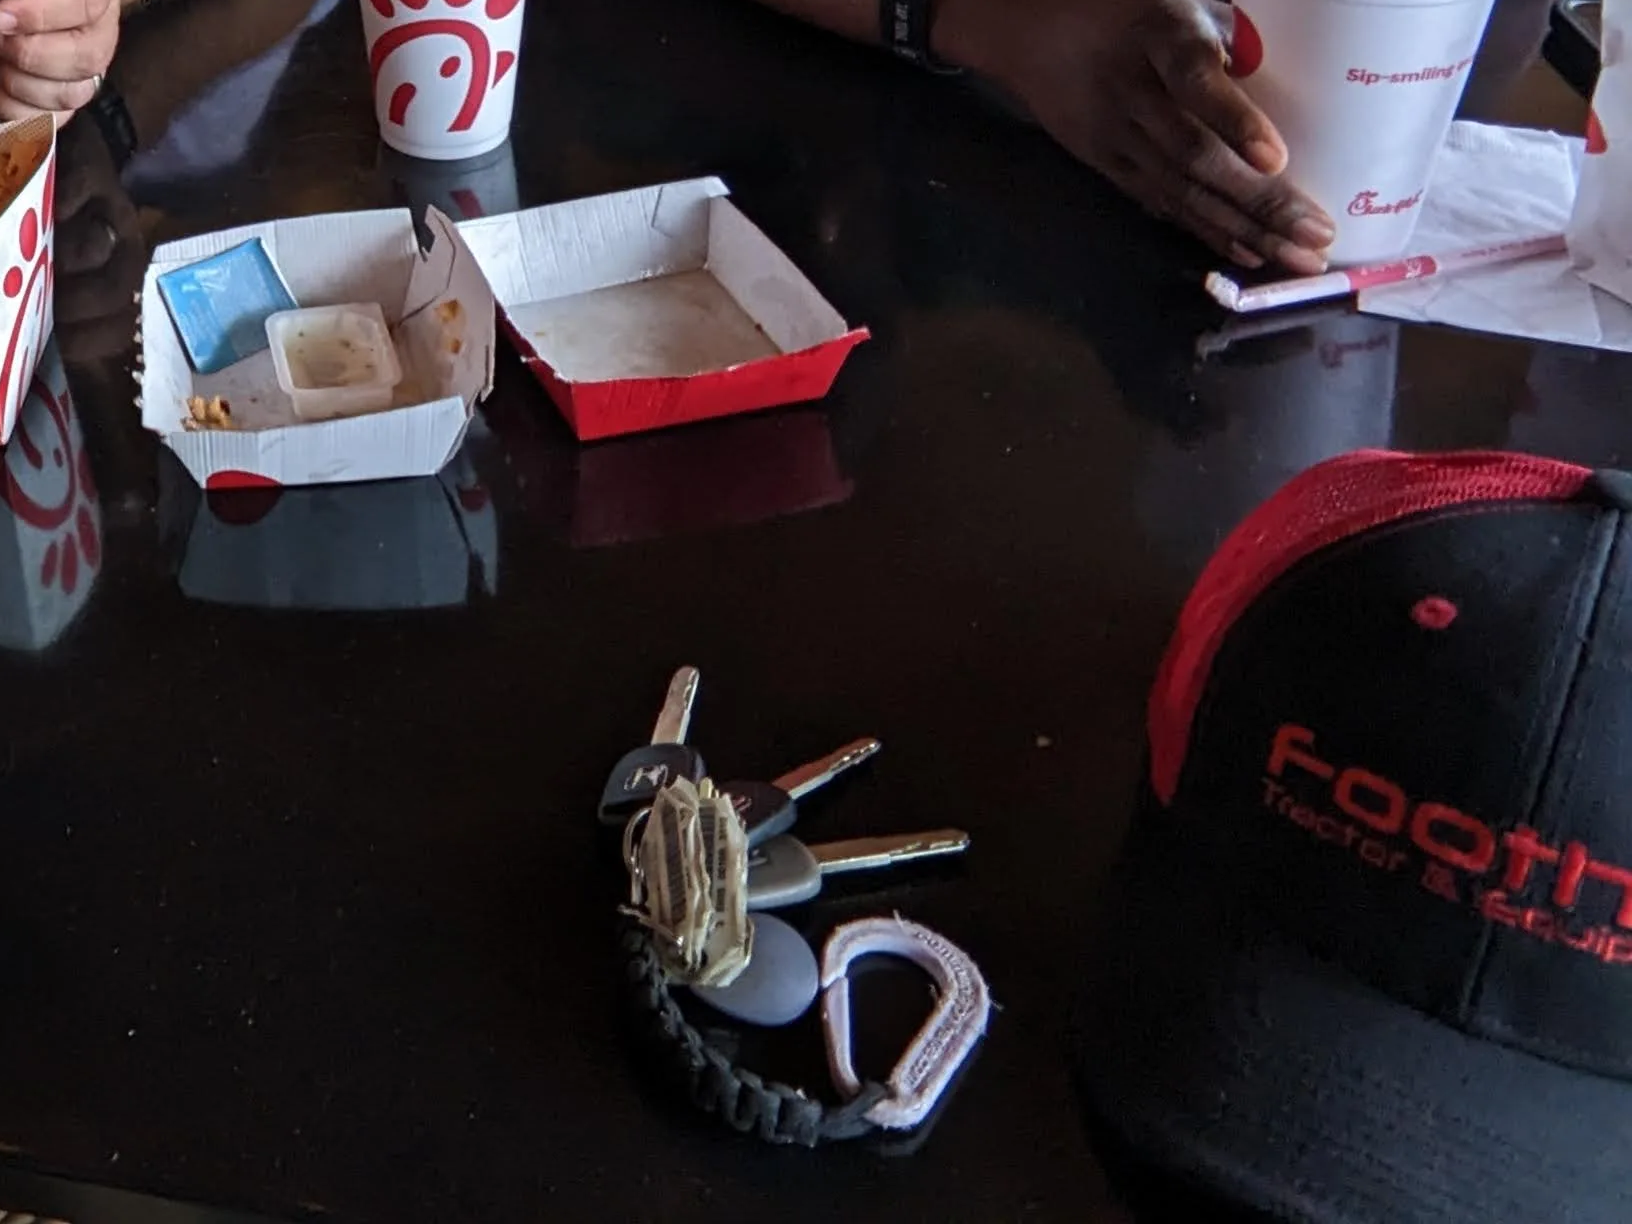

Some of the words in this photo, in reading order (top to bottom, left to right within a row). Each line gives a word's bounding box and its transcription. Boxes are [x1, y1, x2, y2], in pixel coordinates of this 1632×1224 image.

[1346, 65, 1455, 86] Sip-smiling
[1262, 778, 1407, 870] Tractor
[1421, 862, 1460, 902] &
